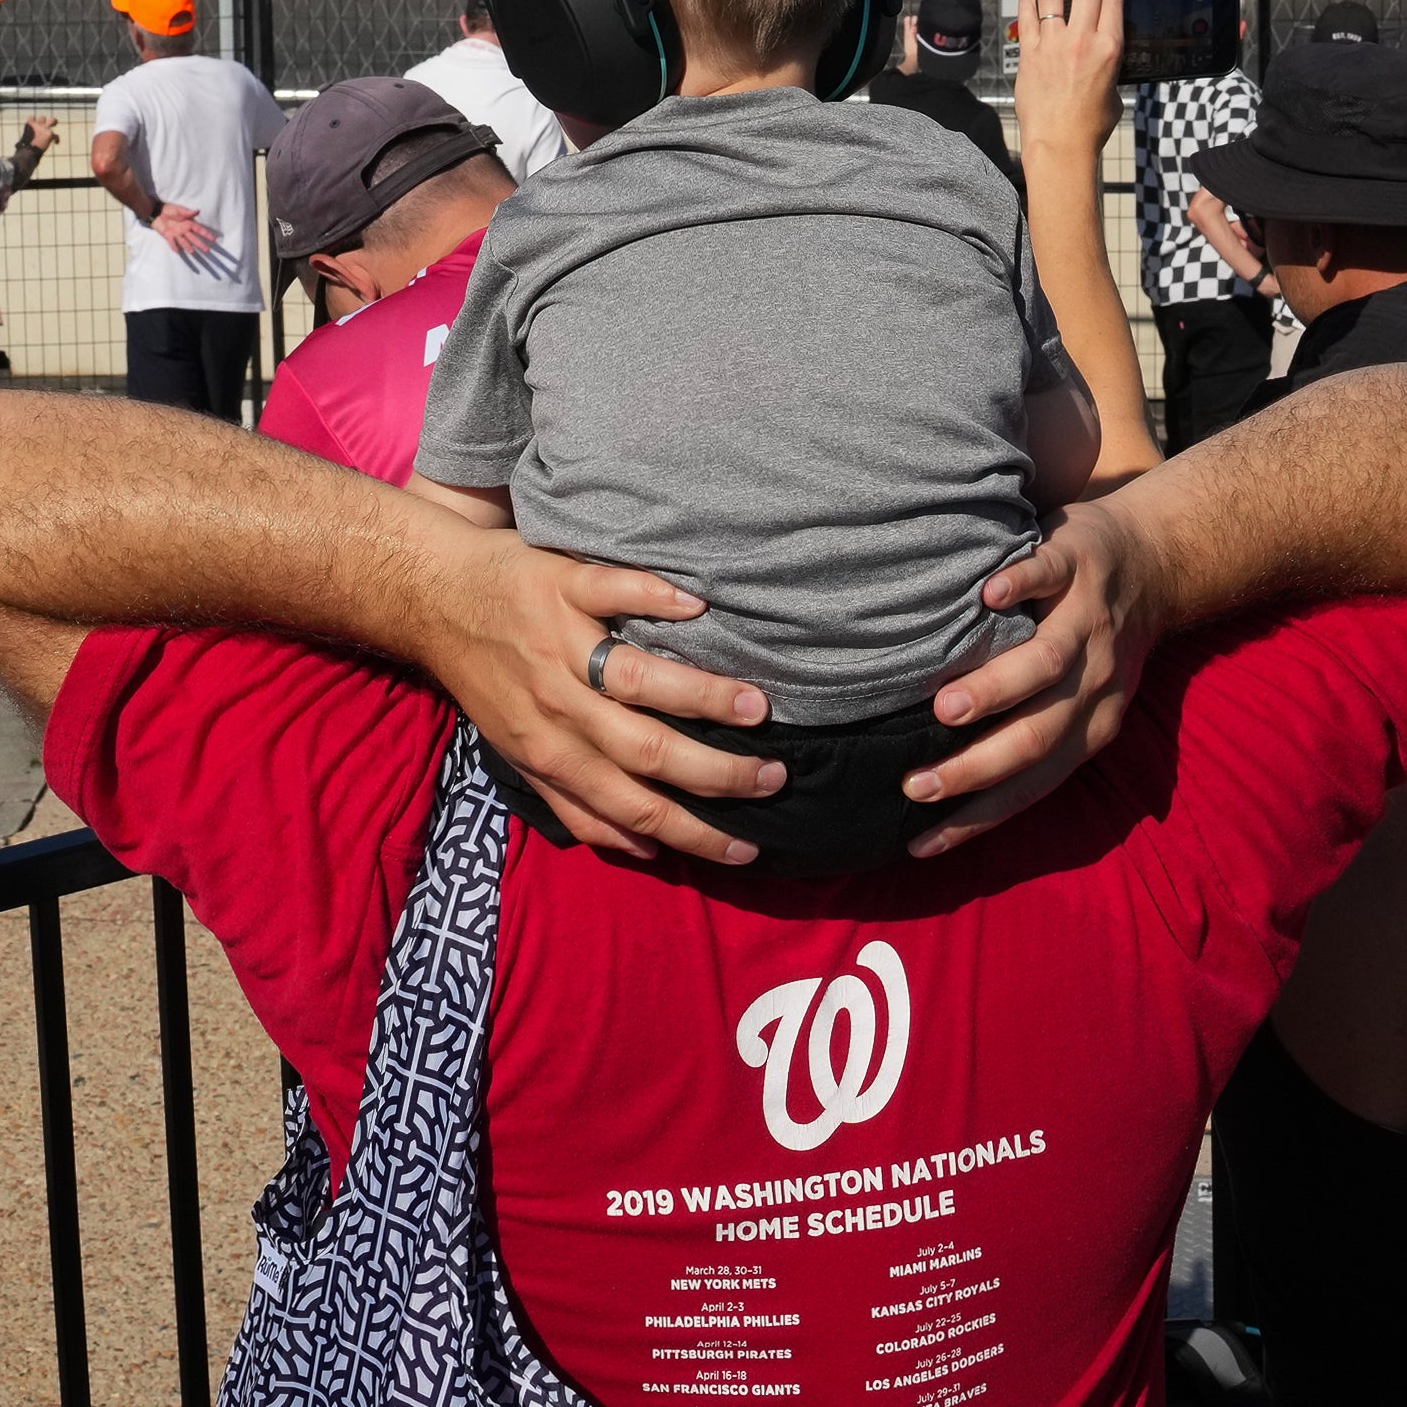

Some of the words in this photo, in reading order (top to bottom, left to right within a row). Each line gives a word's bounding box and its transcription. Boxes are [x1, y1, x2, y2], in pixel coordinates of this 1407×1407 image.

[736, 940, 910, 1151] W
[605, 1189, 675, 1217] 2019
[681, 1163, 884, 1213] WASHINGTON
[891, 1129, 1047, 1187] NATIONALS
[715, 1216, 801, 1243] HOME
[807, 1189, 956, 1238] SCHEDULE
[917, 1246, 935, 1258] July
[889, 1261, 927, 1278] MIAMI
[929, 1246, 982, 1271] MARLINS
[685, 1266, 715, 1276] March
[717, 1266, 732, 1276] 28,
[670, 1279, 701, 1291] NEW
[704, 1278, 740, 1290] YORK
[742, 1278, 777, 1289] METS
[919, 1284, 938, 1296] July
[871, 1299, 923, 1319] KANSAS
[925, 1292, 954, 1309] CITY
[955, 1277, 1001, 1301] ROYALS
[701, 1302, 725, 1313] April
[645, 1315, 740, 1328] PHILADELPHIA
[743, 1314, 800, 1327] PHILLIES
[876, 1331, 945, 1355] COLORADO
[947, 1313, 997, 1339] ROCKIES
[915, 1322, 933, 1334] July
[697, 1340, 720, 1348] April
[652, 1349, 734, 1360] PITTSBURGH
[737, 1349, 792, 1360] PIRATES
[865, 1378, 891, 1391] LOS
[893, 1365, 949, 1389] ANGELES
[951, 1343, 1005, 1373] DODGERS
[915, 1358, 933, 1370] July
[696, 1370, 720, 1382] April
[642, 1382, 670, 1393] SAN
[673, 1384, 749, 1396] FRANCISCO
[751, 1383, 801, 1396] GIANTS
[944, 1382, 987, 1407] BRAVES
[917, 1393, 935, 1405] July
